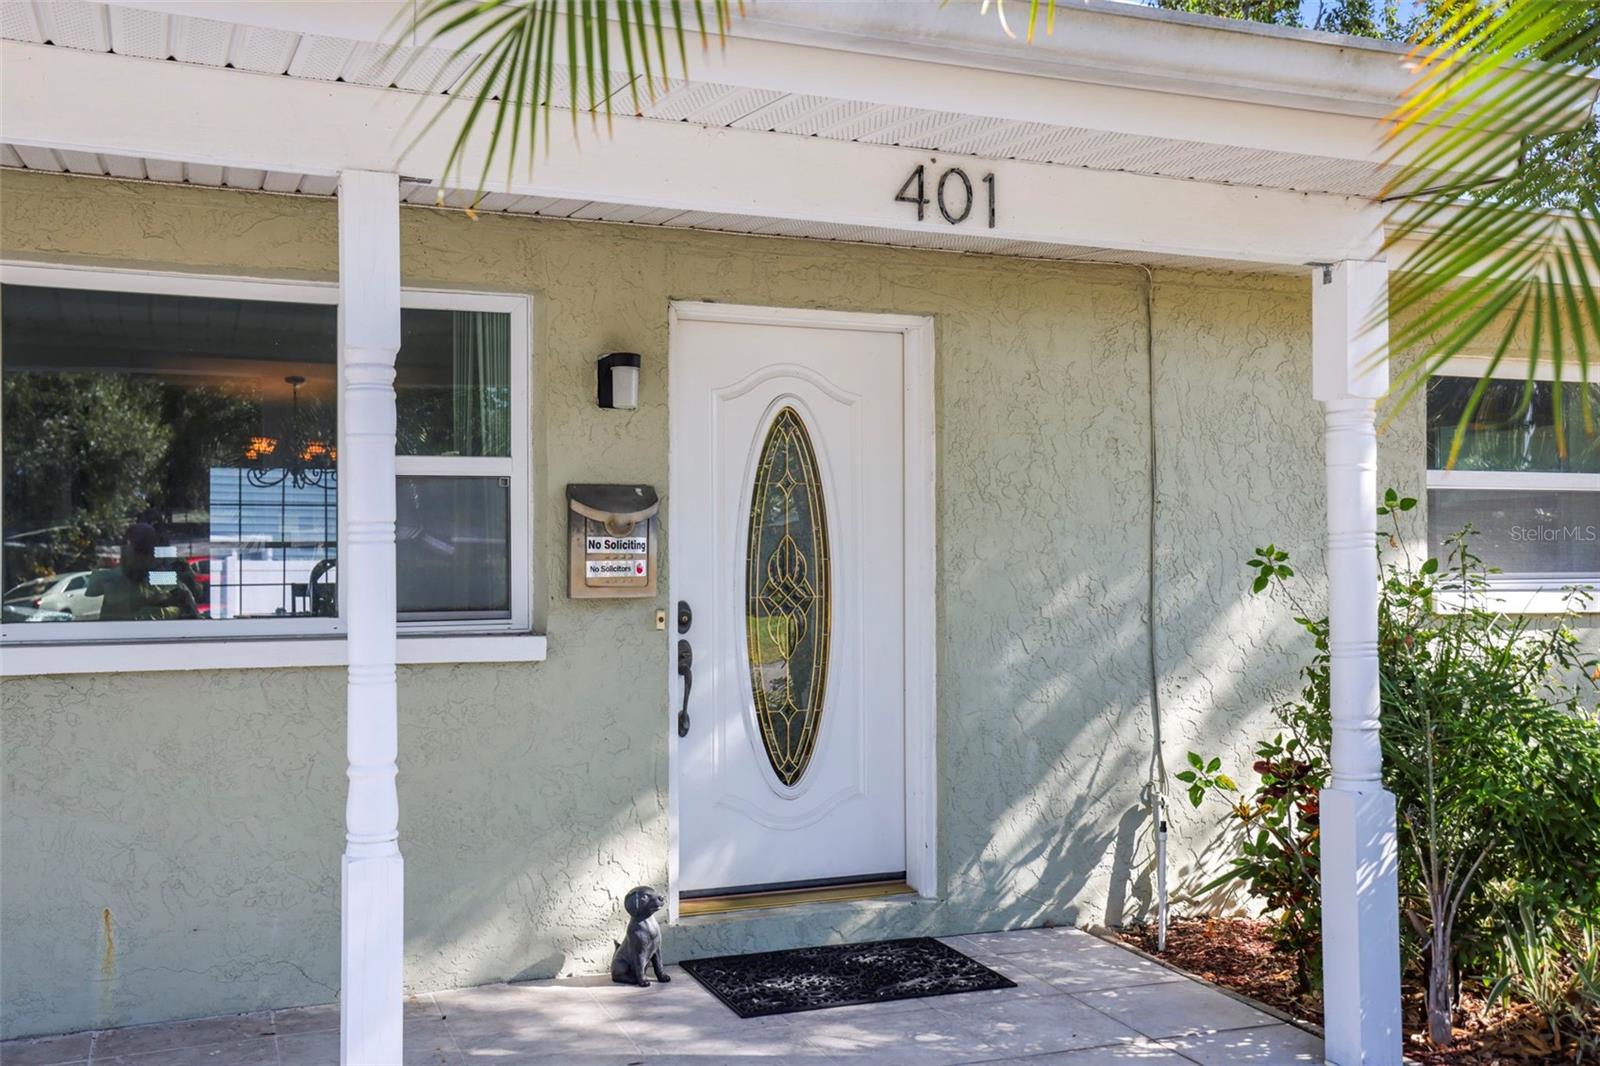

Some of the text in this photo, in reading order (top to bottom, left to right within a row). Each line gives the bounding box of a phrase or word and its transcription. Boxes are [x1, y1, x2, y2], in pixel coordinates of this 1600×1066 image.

[895, 164, 996, 229] 401
[588, 540, 646, 552] No Soliciting
